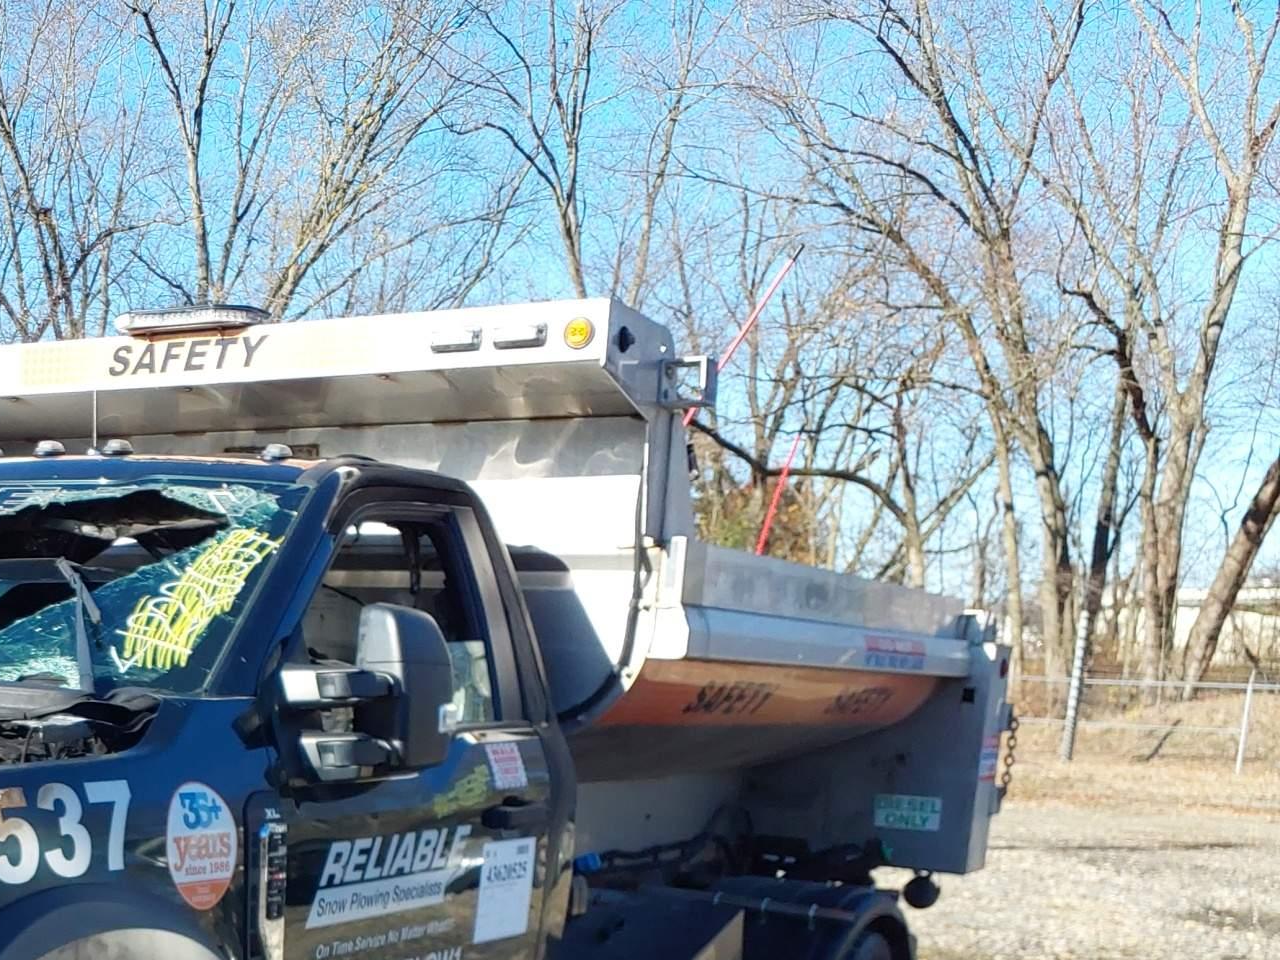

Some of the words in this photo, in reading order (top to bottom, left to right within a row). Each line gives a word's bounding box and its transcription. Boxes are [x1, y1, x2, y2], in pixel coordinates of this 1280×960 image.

[108, 334, 270, 377] SAFETY
[178, 792, 222, 829] 35+
[885, 812, 930, 826] ONLY
[173, 832, 232, 872] years
[185, 864, 208, 876] since
[320, 825, 472, 887] RELIABLE
[317, 896, 348, 917] Snow
[350, 886, 390, 910] Plowing
[392, 880, 443, 903] Specialists
[316, 944, 329, 960] On
[333, 940, 353, 954] Time
[356, 934, 386, 950] Service
[388, 930, 399, 942] No
